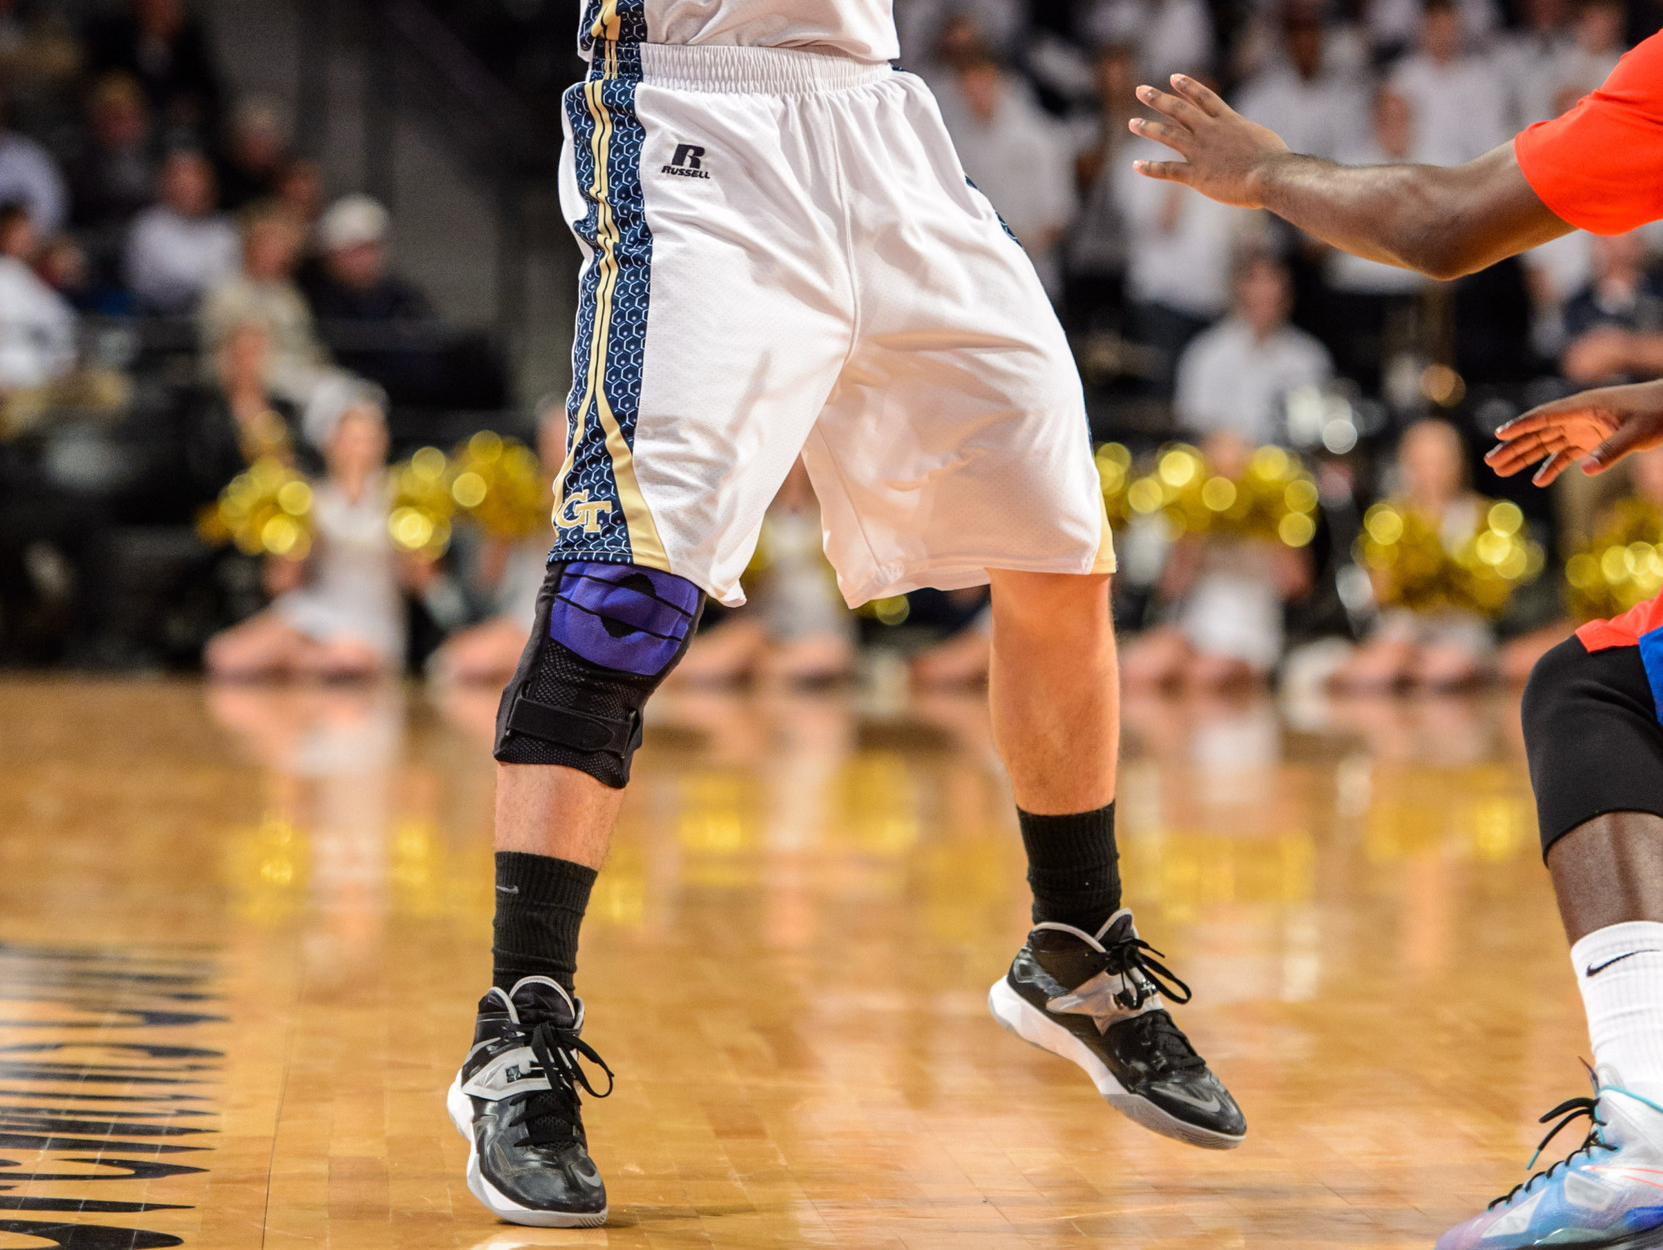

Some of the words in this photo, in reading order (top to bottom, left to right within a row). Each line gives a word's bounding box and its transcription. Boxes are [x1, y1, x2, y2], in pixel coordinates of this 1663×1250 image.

[672, 143, 705, 169] R
[661, 165, 710, 179] RUSSELL
[555, 489, 612, 532] GT
